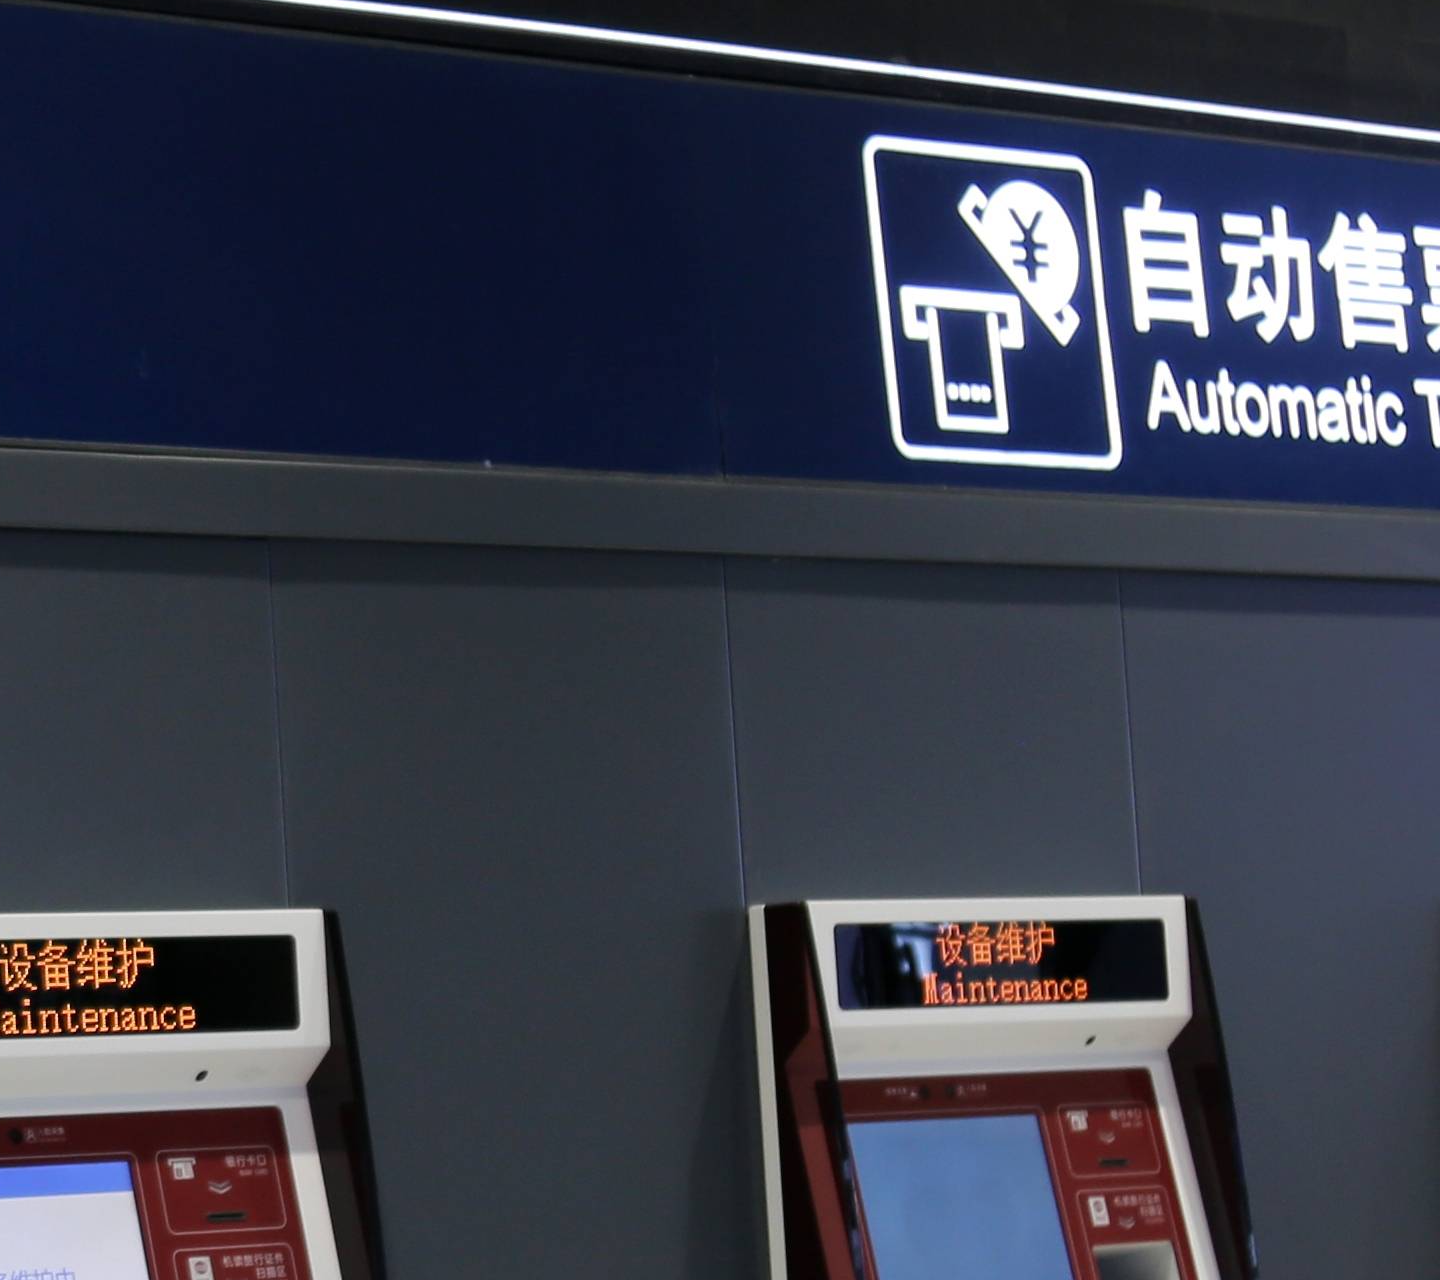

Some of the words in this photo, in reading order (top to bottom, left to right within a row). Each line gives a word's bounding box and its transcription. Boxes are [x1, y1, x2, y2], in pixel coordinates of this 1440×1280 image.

[1147, 360, 1407, 446] Automatic
[936, 922, 1055, 966] 设备维护
[924, 972, 1087, 1004] Maintenance
